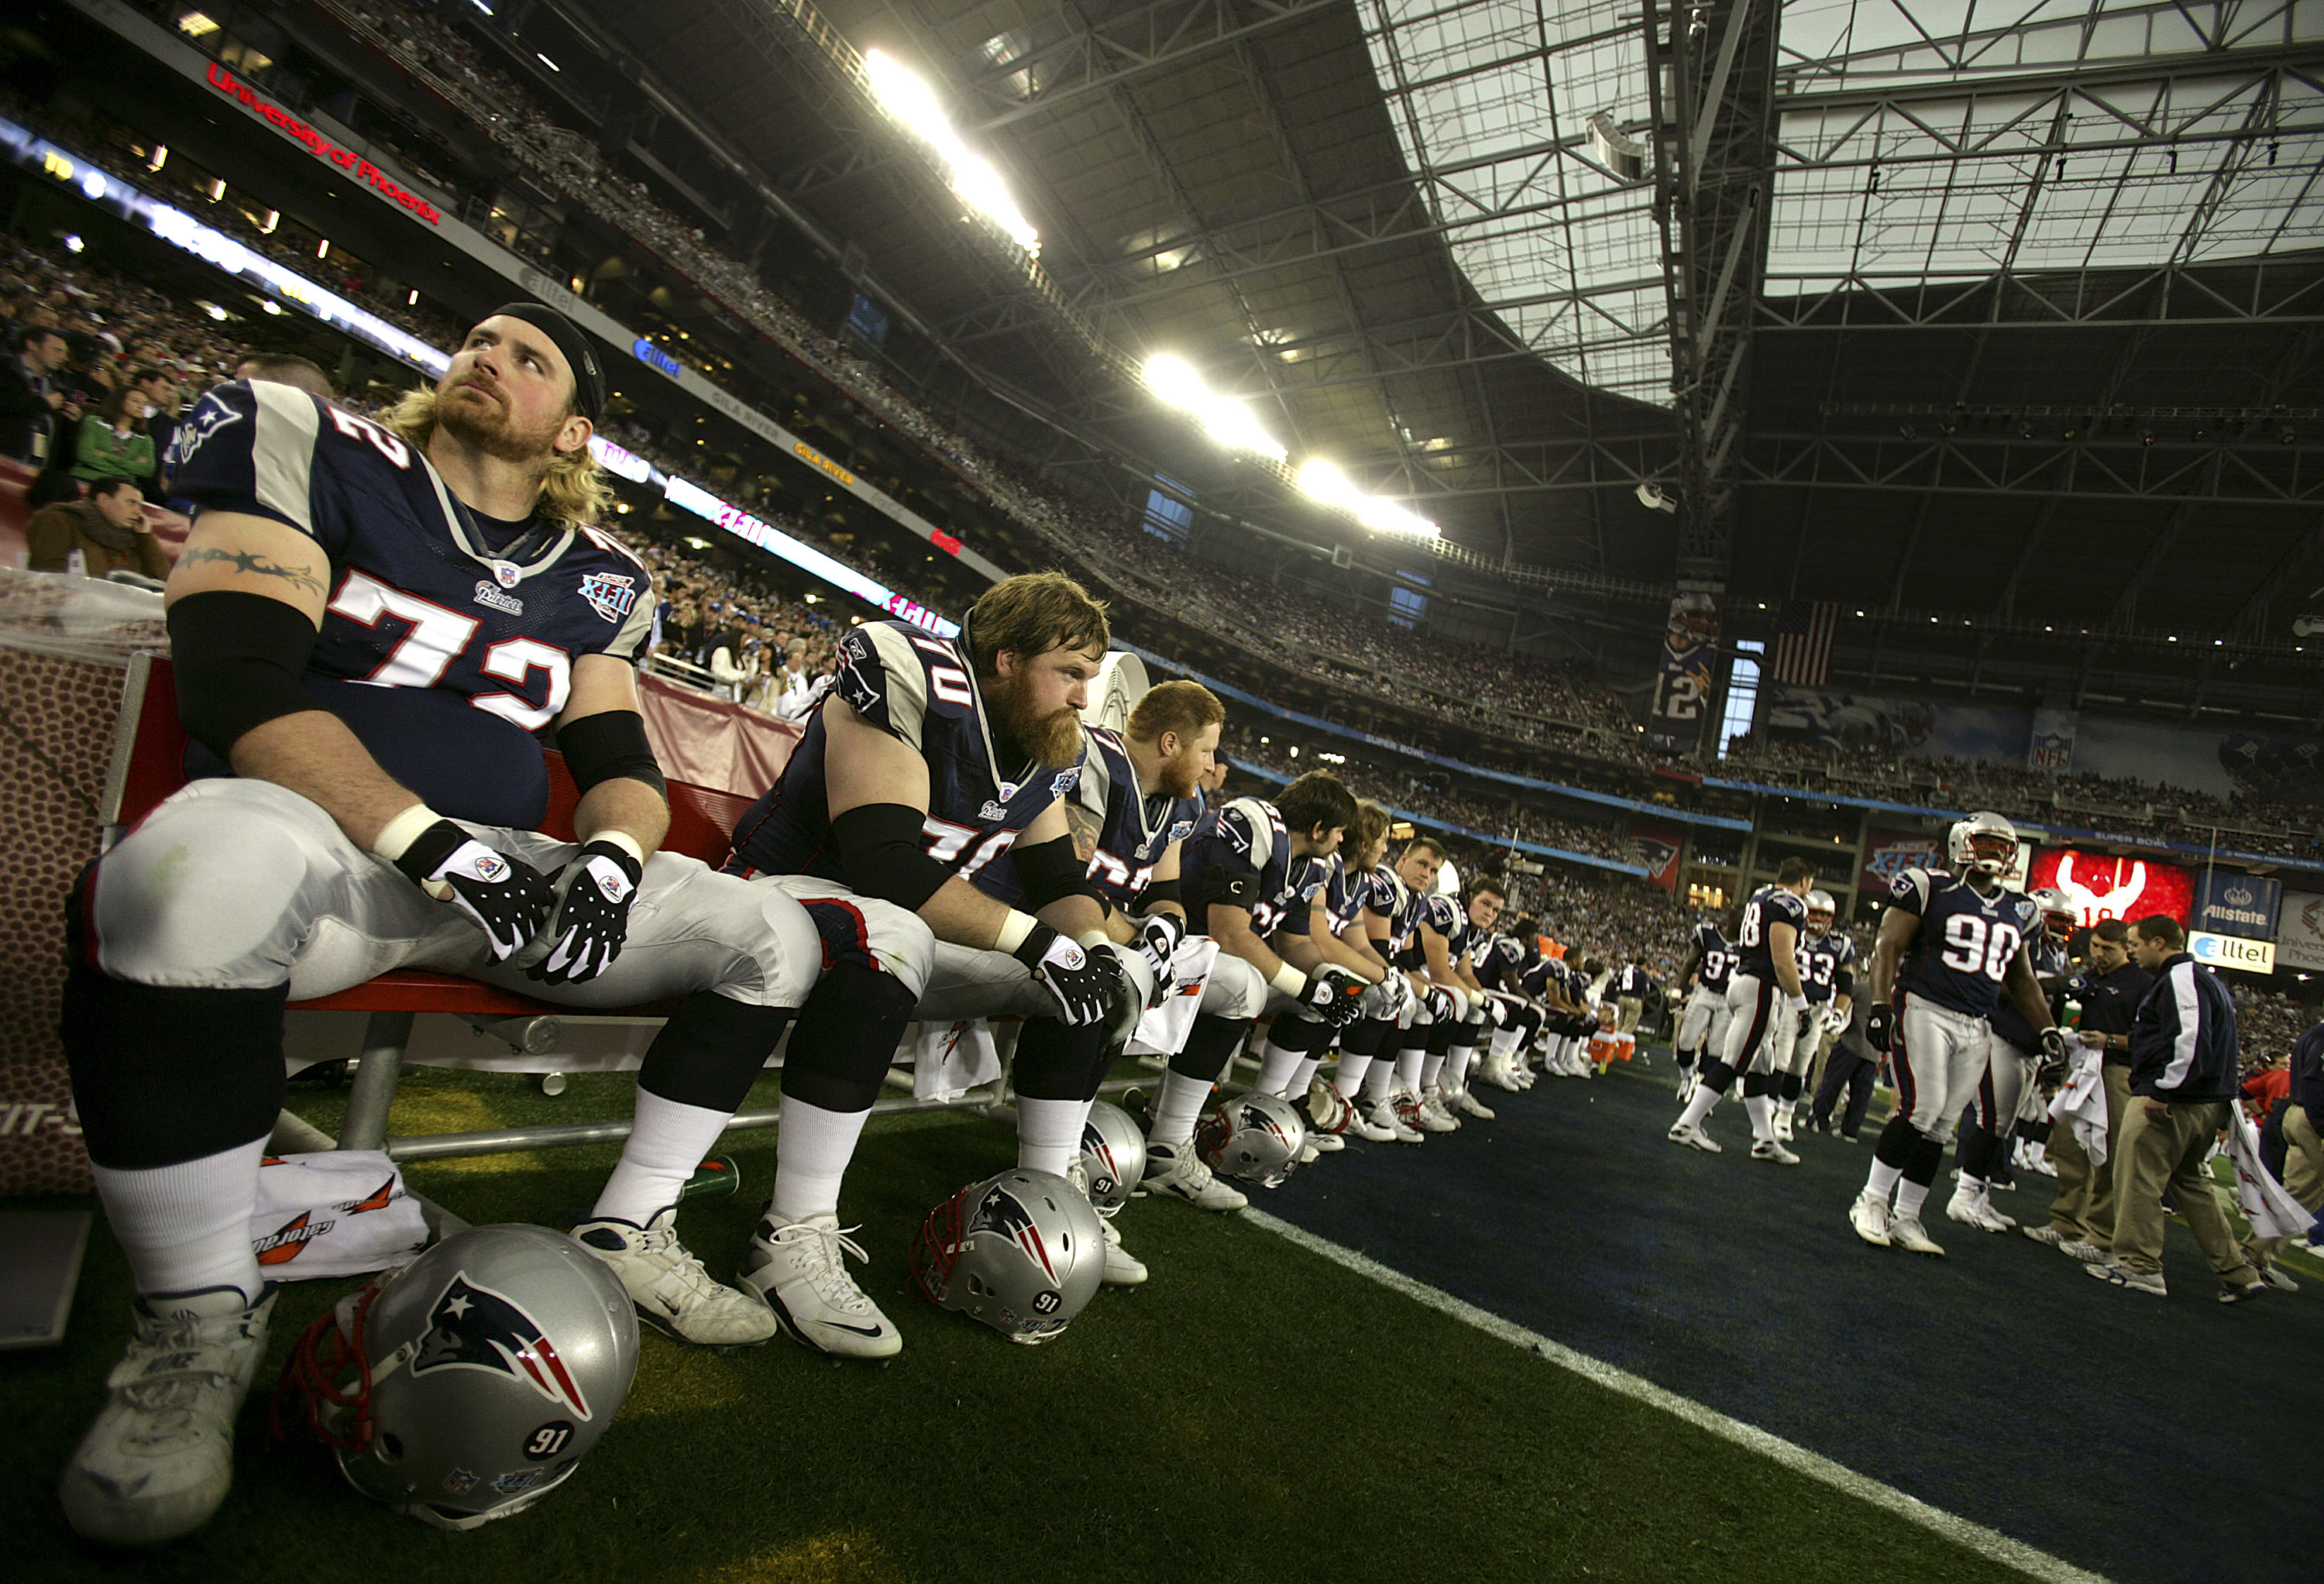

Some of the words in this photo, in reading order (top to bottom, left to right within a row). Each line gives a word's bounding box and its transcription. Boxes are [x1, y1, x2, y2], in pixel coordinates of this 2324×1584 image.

[207, 62, 332, 155] University
[329, 148, 359, 169] of
[356, 160, 441, 225] Phoenix
[634, 338, 682, 378] alltel
[794, 442, 820, 466] GILA
[822, 459, 854, 486] RIVER
[476, 589, 523, 613] Patriots
[326, 565, 572, 733] 72
[1652, 672, 1700, 719] 12
[1366, 733, 1397, 751] SUPER
[2034, 748, 2068, 766] NFL
[2094, 831, 2133, 844] SUPER
[2136, 837, 2169, 849] BOWL
[2202, 904, 2267, 926] Allstate
[1941, 912, 2021, 983] 90
[2194, 936, 2267, 964] alltel
[1095, 1179, 1112, 1193] 91
[1035, 1294, 1059, 1313] 91
[528, 1428, 569, 1454] 91
